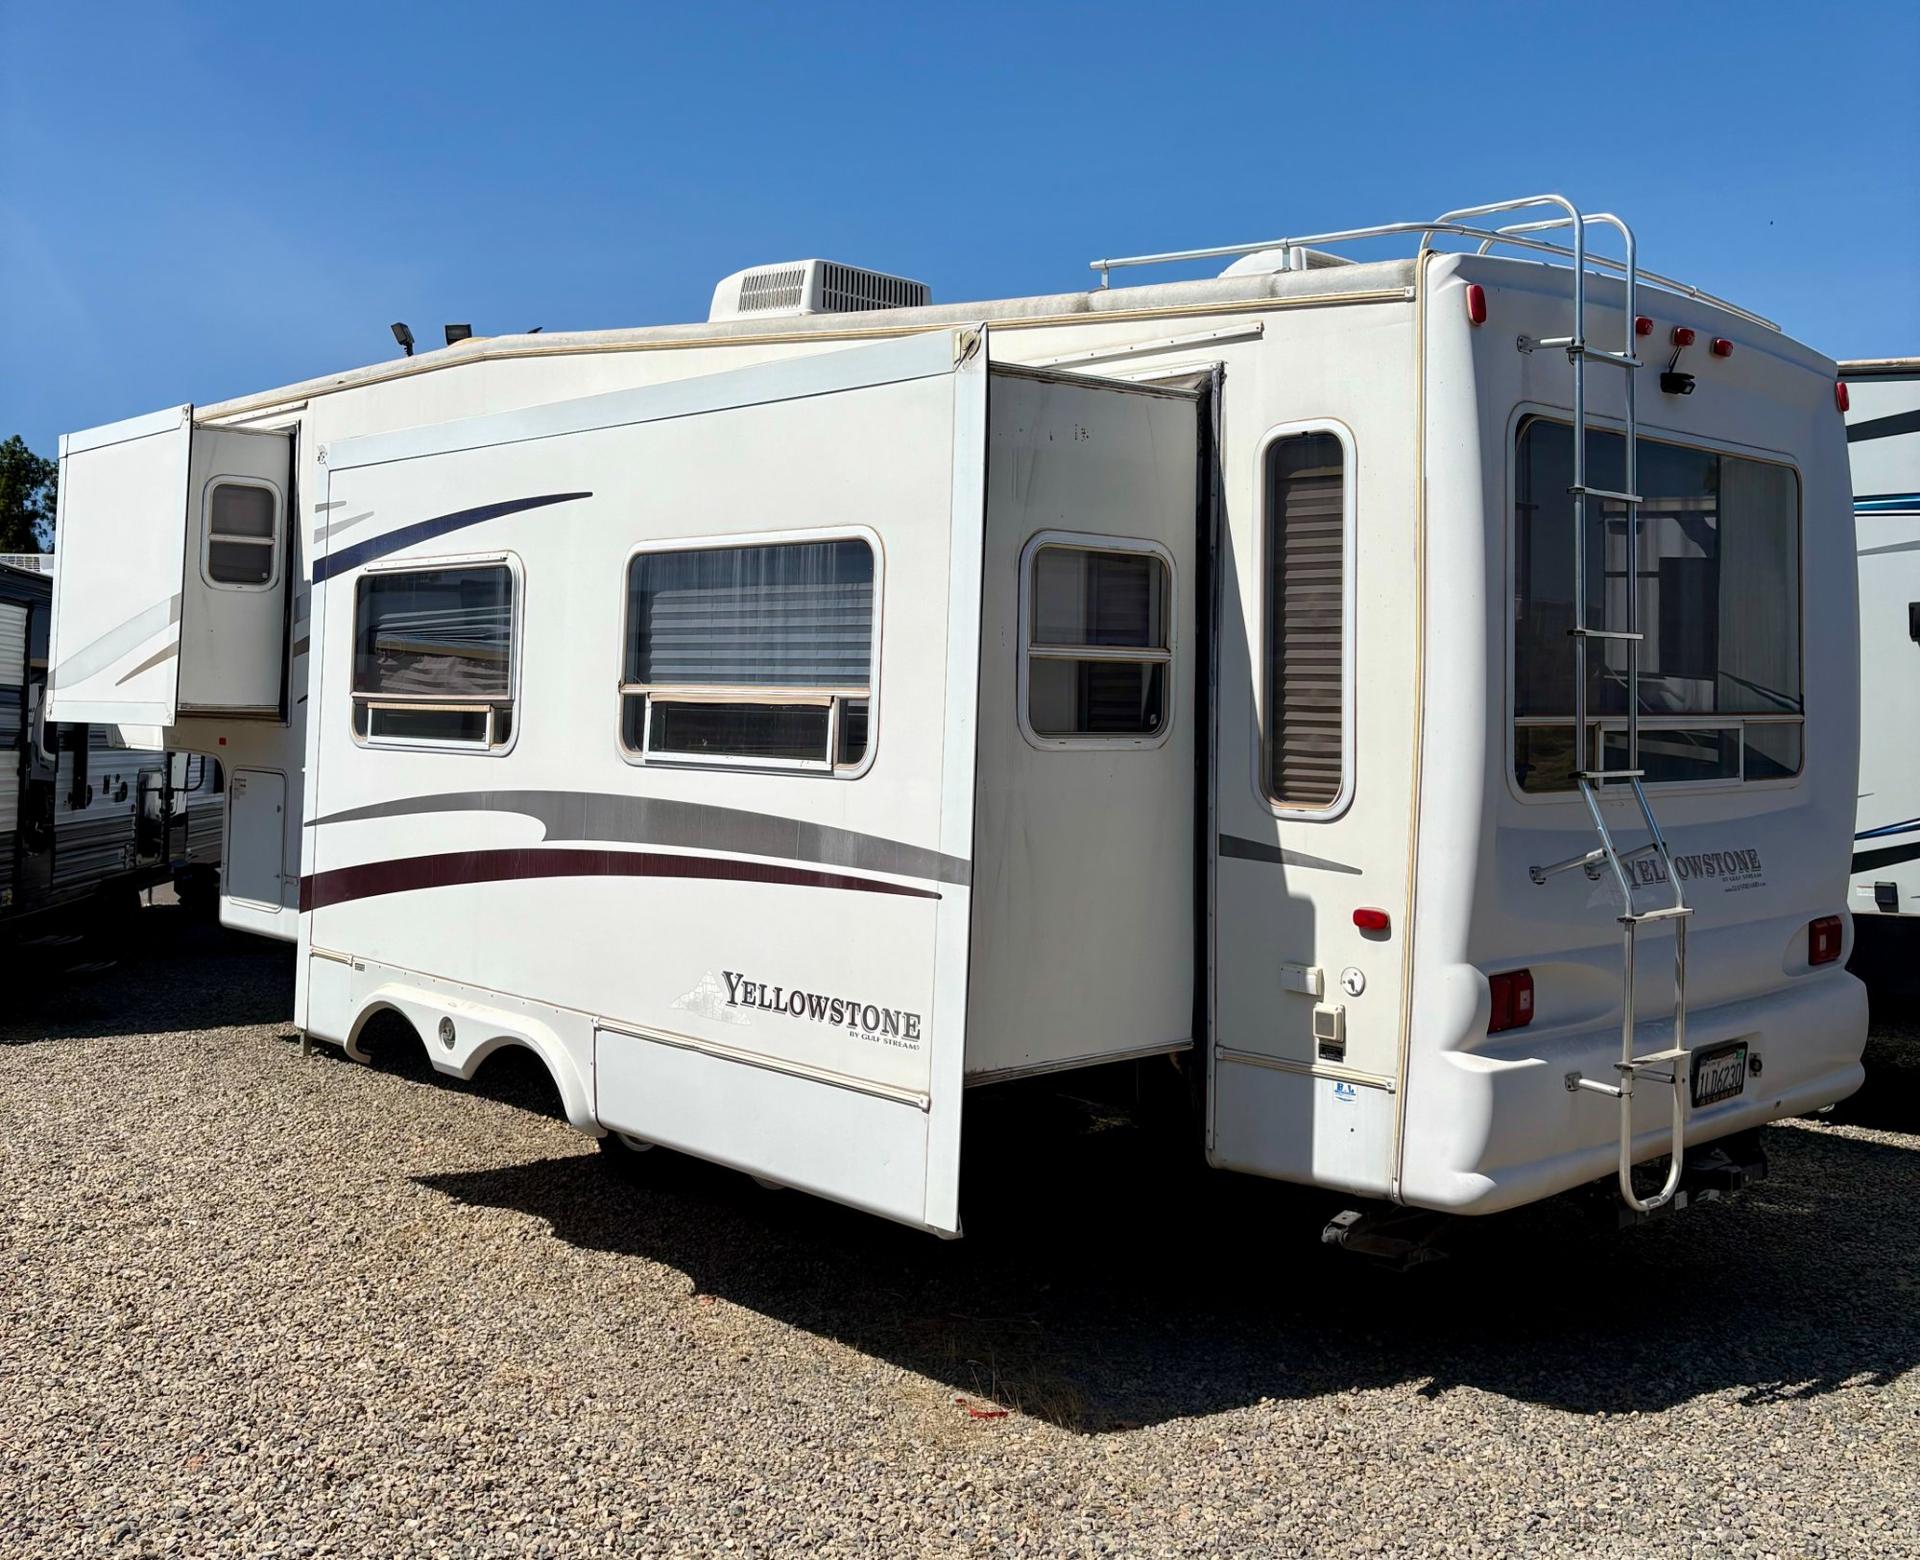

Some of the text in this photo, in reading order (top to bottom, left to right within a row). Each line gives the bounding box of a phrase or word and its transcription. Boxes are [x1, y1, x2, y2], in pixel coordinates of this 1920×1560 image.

[1622, 849, 1761, 889] YELOWSTONE
[722, 970, 921, 1042] YELLOWSTONE
[849, 1030, 860, 1039] BY
[861, 1033, 881, 1043] GULF
